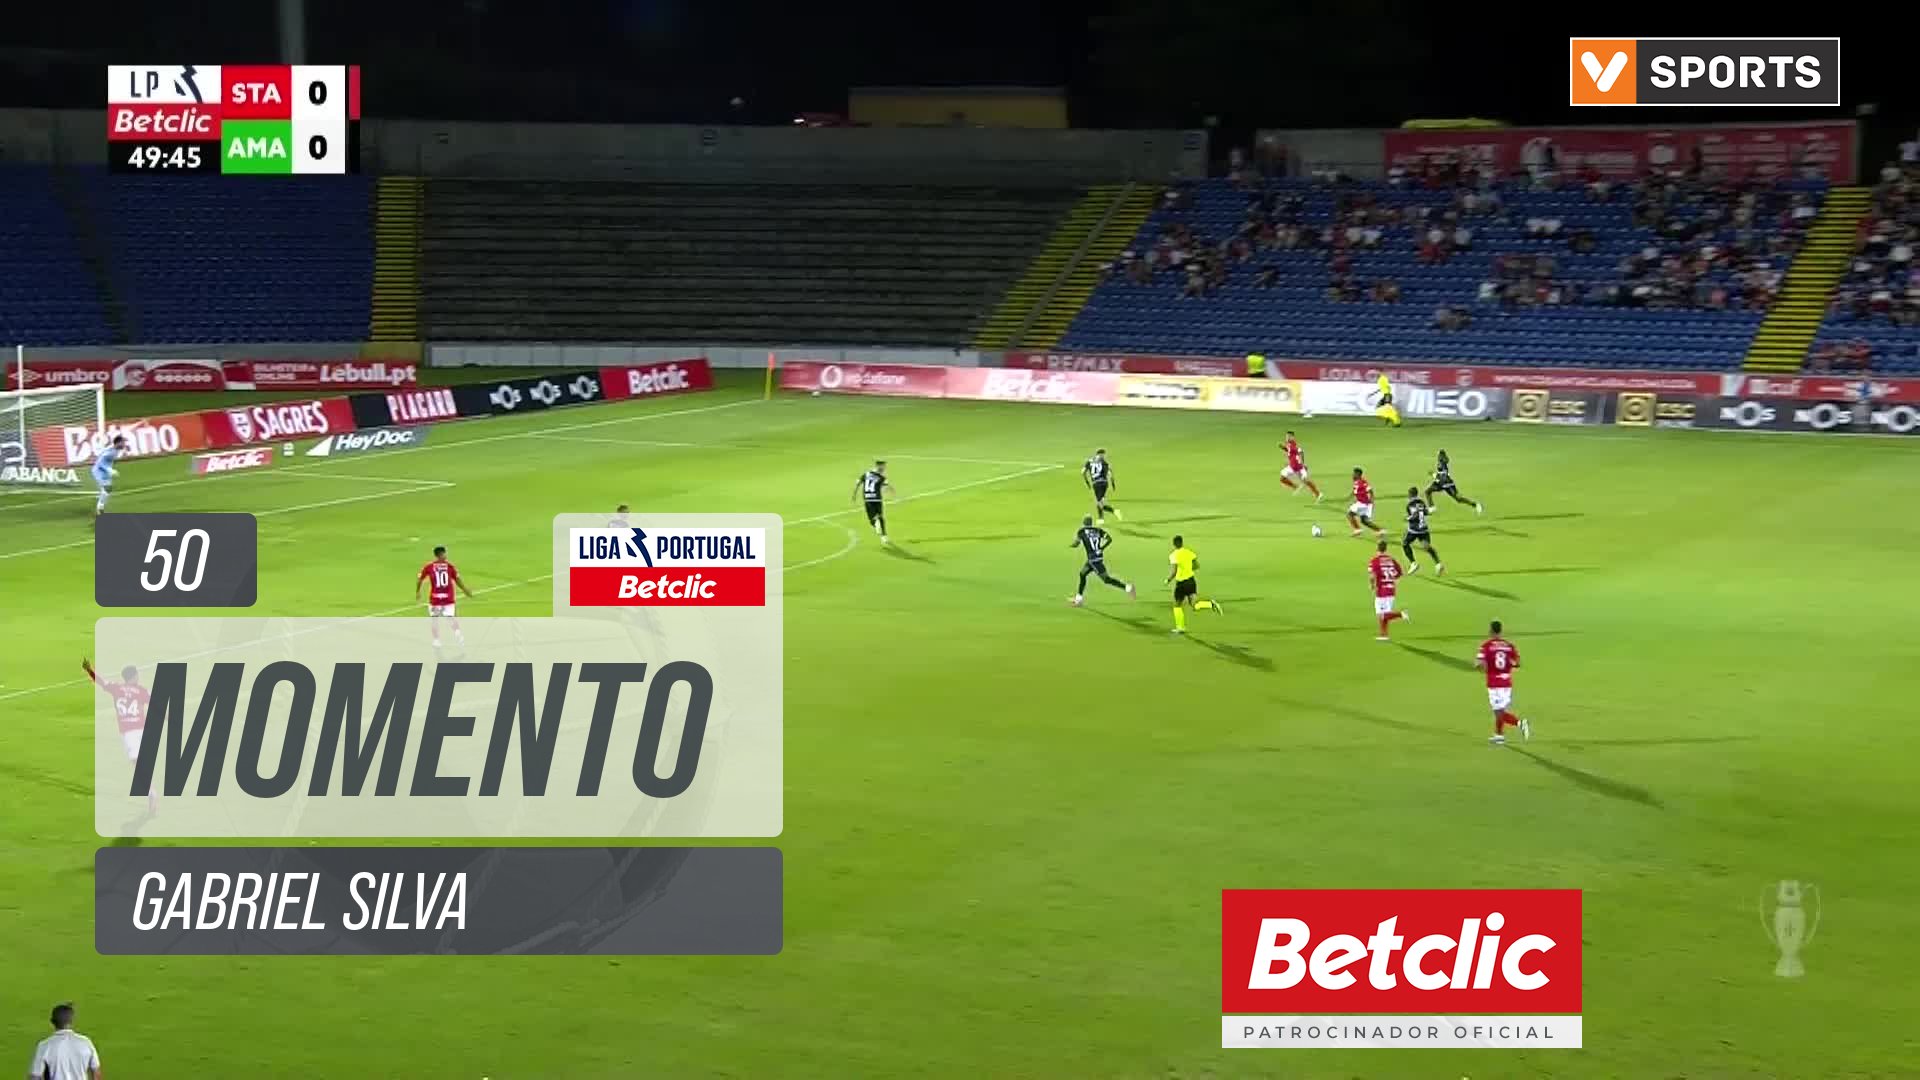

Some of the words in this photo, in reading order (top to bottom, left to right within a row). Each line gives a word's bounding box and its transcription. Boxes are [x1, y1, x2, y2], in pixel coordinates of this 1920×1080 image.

[45, 368, 110, 383] umbro
[319, 363, 417, 386] Lebull.pt
[628, 363, 690, 395] Betclic
[1407, 389, 1488, 416] MEO
[254, 401, 329, 440] SAGRES
[206, 450, 264, 473] Betclic
[7, 466, 80, 483] ABANCA
[434, 571, 449, 588] 10
[1495, 651, 1506, 670] 8
